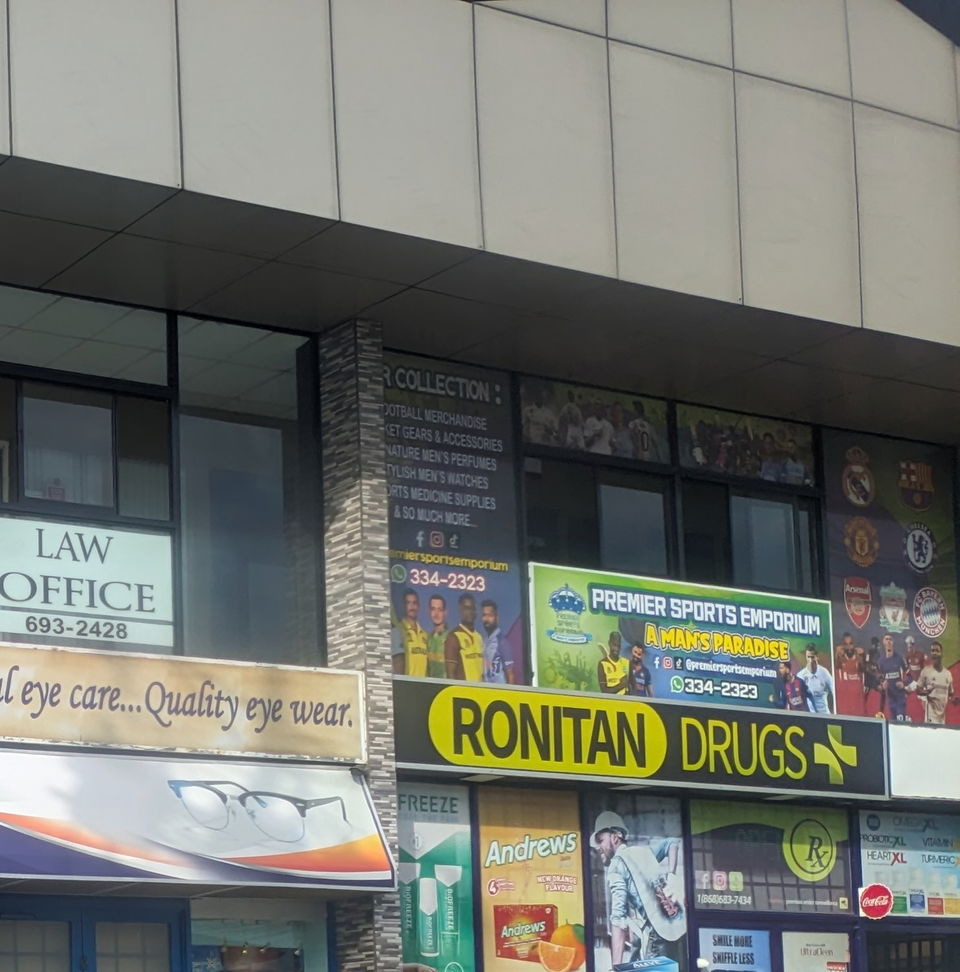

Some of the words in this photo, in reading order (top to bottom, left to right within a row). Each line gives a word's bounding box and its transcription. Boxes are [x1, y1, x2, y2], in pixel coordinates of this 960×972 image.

[395, 368, 490, 403] COLLECTION
[424, 408, 487, 431] MERCHANDISE
[402, 427, 433, 442] GEARS
[434, 431, 441, 443] &
[443, 432, 504, 453] ACCESSORIES
[422, 449, 449, 465] MEN'S
[451, 453, 497, 471] PERFUMES
[418, 468, 446, 484] MEN'S
[448, 473, 489, 490] WATCHES
[410, 487, 453, 505] MEDICINE
[455, 492, 497, 511] SUPPLIES
[394, 505, 401, 518] &
[403, 506, 415, 520] SO
[417, 508, 443, 523] MUCH
[35, 528, 114, 565] LAW
[410, 568, 486, 592] 334-2323
[845, 584, 869, 595] Arsenal
[592, 588, 667, 617] PREMIER
[670, 598, 738, 626] SPORTS
[740, 606, 821, 636] EMPORIUM
[25, 615, 128, 640] 693-2428
[645, 624, 658, 647] A
[660, 627, 711, 652] MAN'S
[711, 631, 790, 662] PARADISE
[684, 678, 758, 699] 334-2323
[20, 678, 61, 720] eye
[245, 698, 283, 734] eye
[290, 699, 353, 728] wear.
[452, 697, 647, 769] RONITAN
[680, 717, 807, 781] DRUGS
[484, 832, 578, 869] Andrews
[501, 920, 546, 939] Andrews
[712, 934, 733, 947] SMILE
[738, 952, 755, 965] LESS
